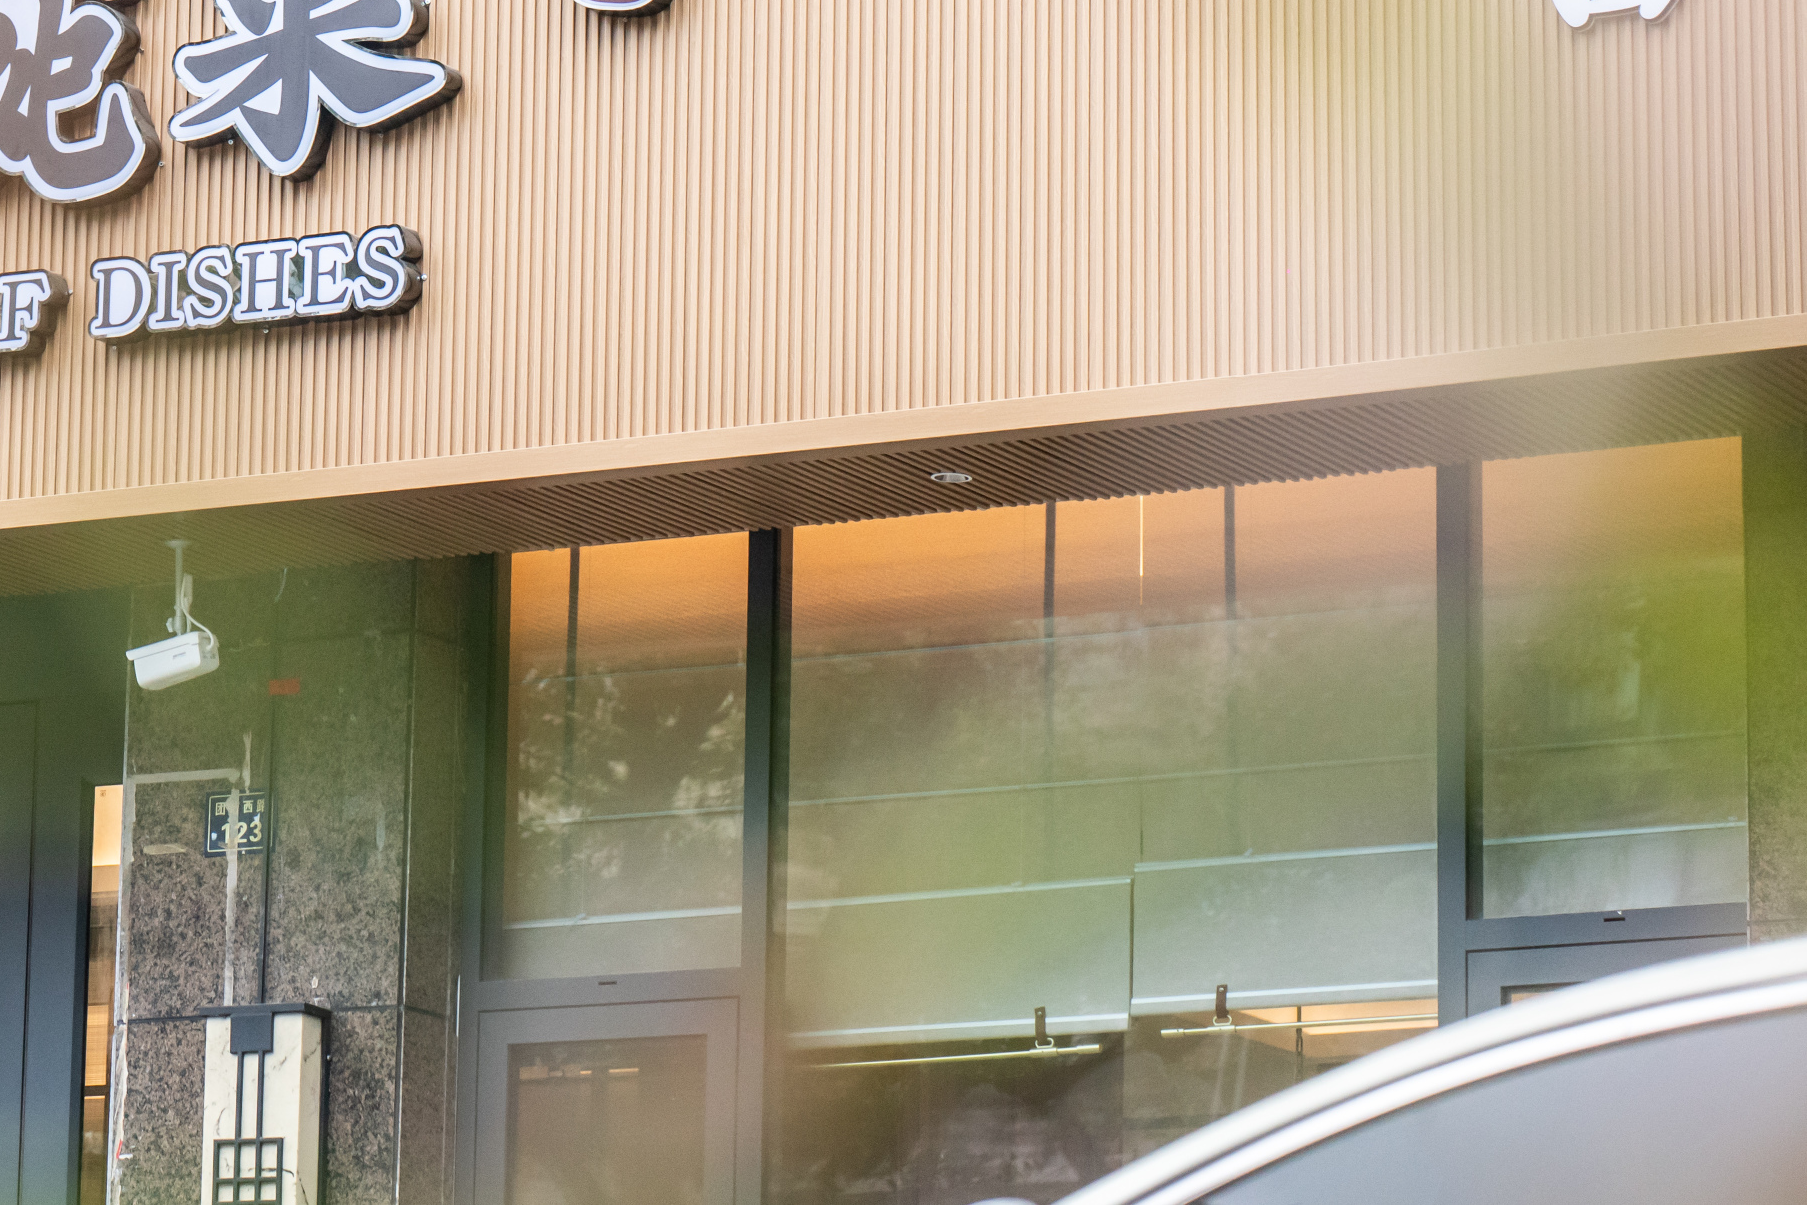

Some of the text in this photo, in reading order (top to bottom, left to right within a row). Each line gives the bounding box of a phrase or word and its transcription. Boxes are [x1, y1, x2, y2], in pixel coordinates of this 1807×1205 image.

[89, 225, 409, 341] DISHES
[215, 799, 265, 816] 团西路
[221, 821, 263, 845] 123
